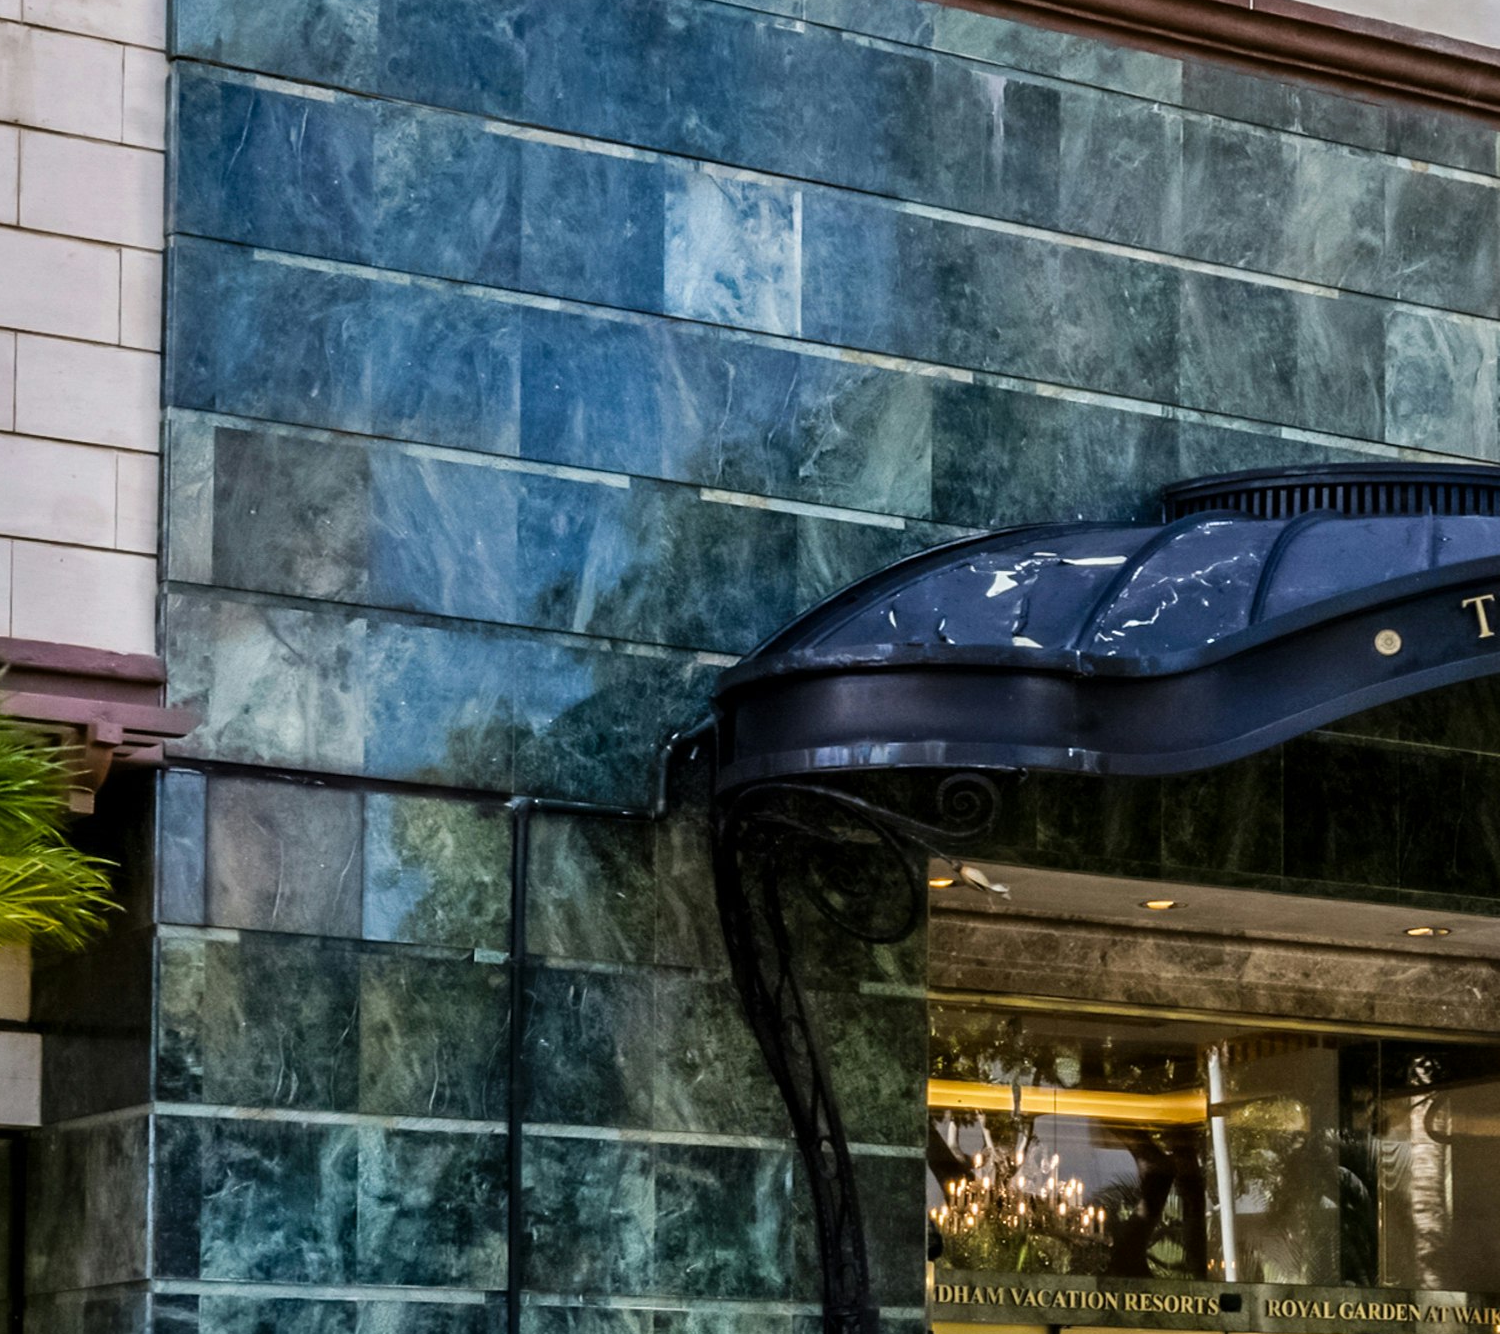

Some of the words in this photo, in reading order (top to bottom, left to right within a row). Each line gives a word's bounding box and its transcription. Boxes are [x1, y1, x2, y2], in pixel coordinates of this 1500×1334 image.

[933, 1284, 1004, 1305] DHAM
[1010, 1288, 1119, 1309] VACATION
[1124, 1293, 1219, 1315] RESORTS
[1267, 1299, 1335, 1320] ROYAL
[1339, 1302, 1421, 1322] GARDEN
[1426, 1306, 1450, 1323] AT
